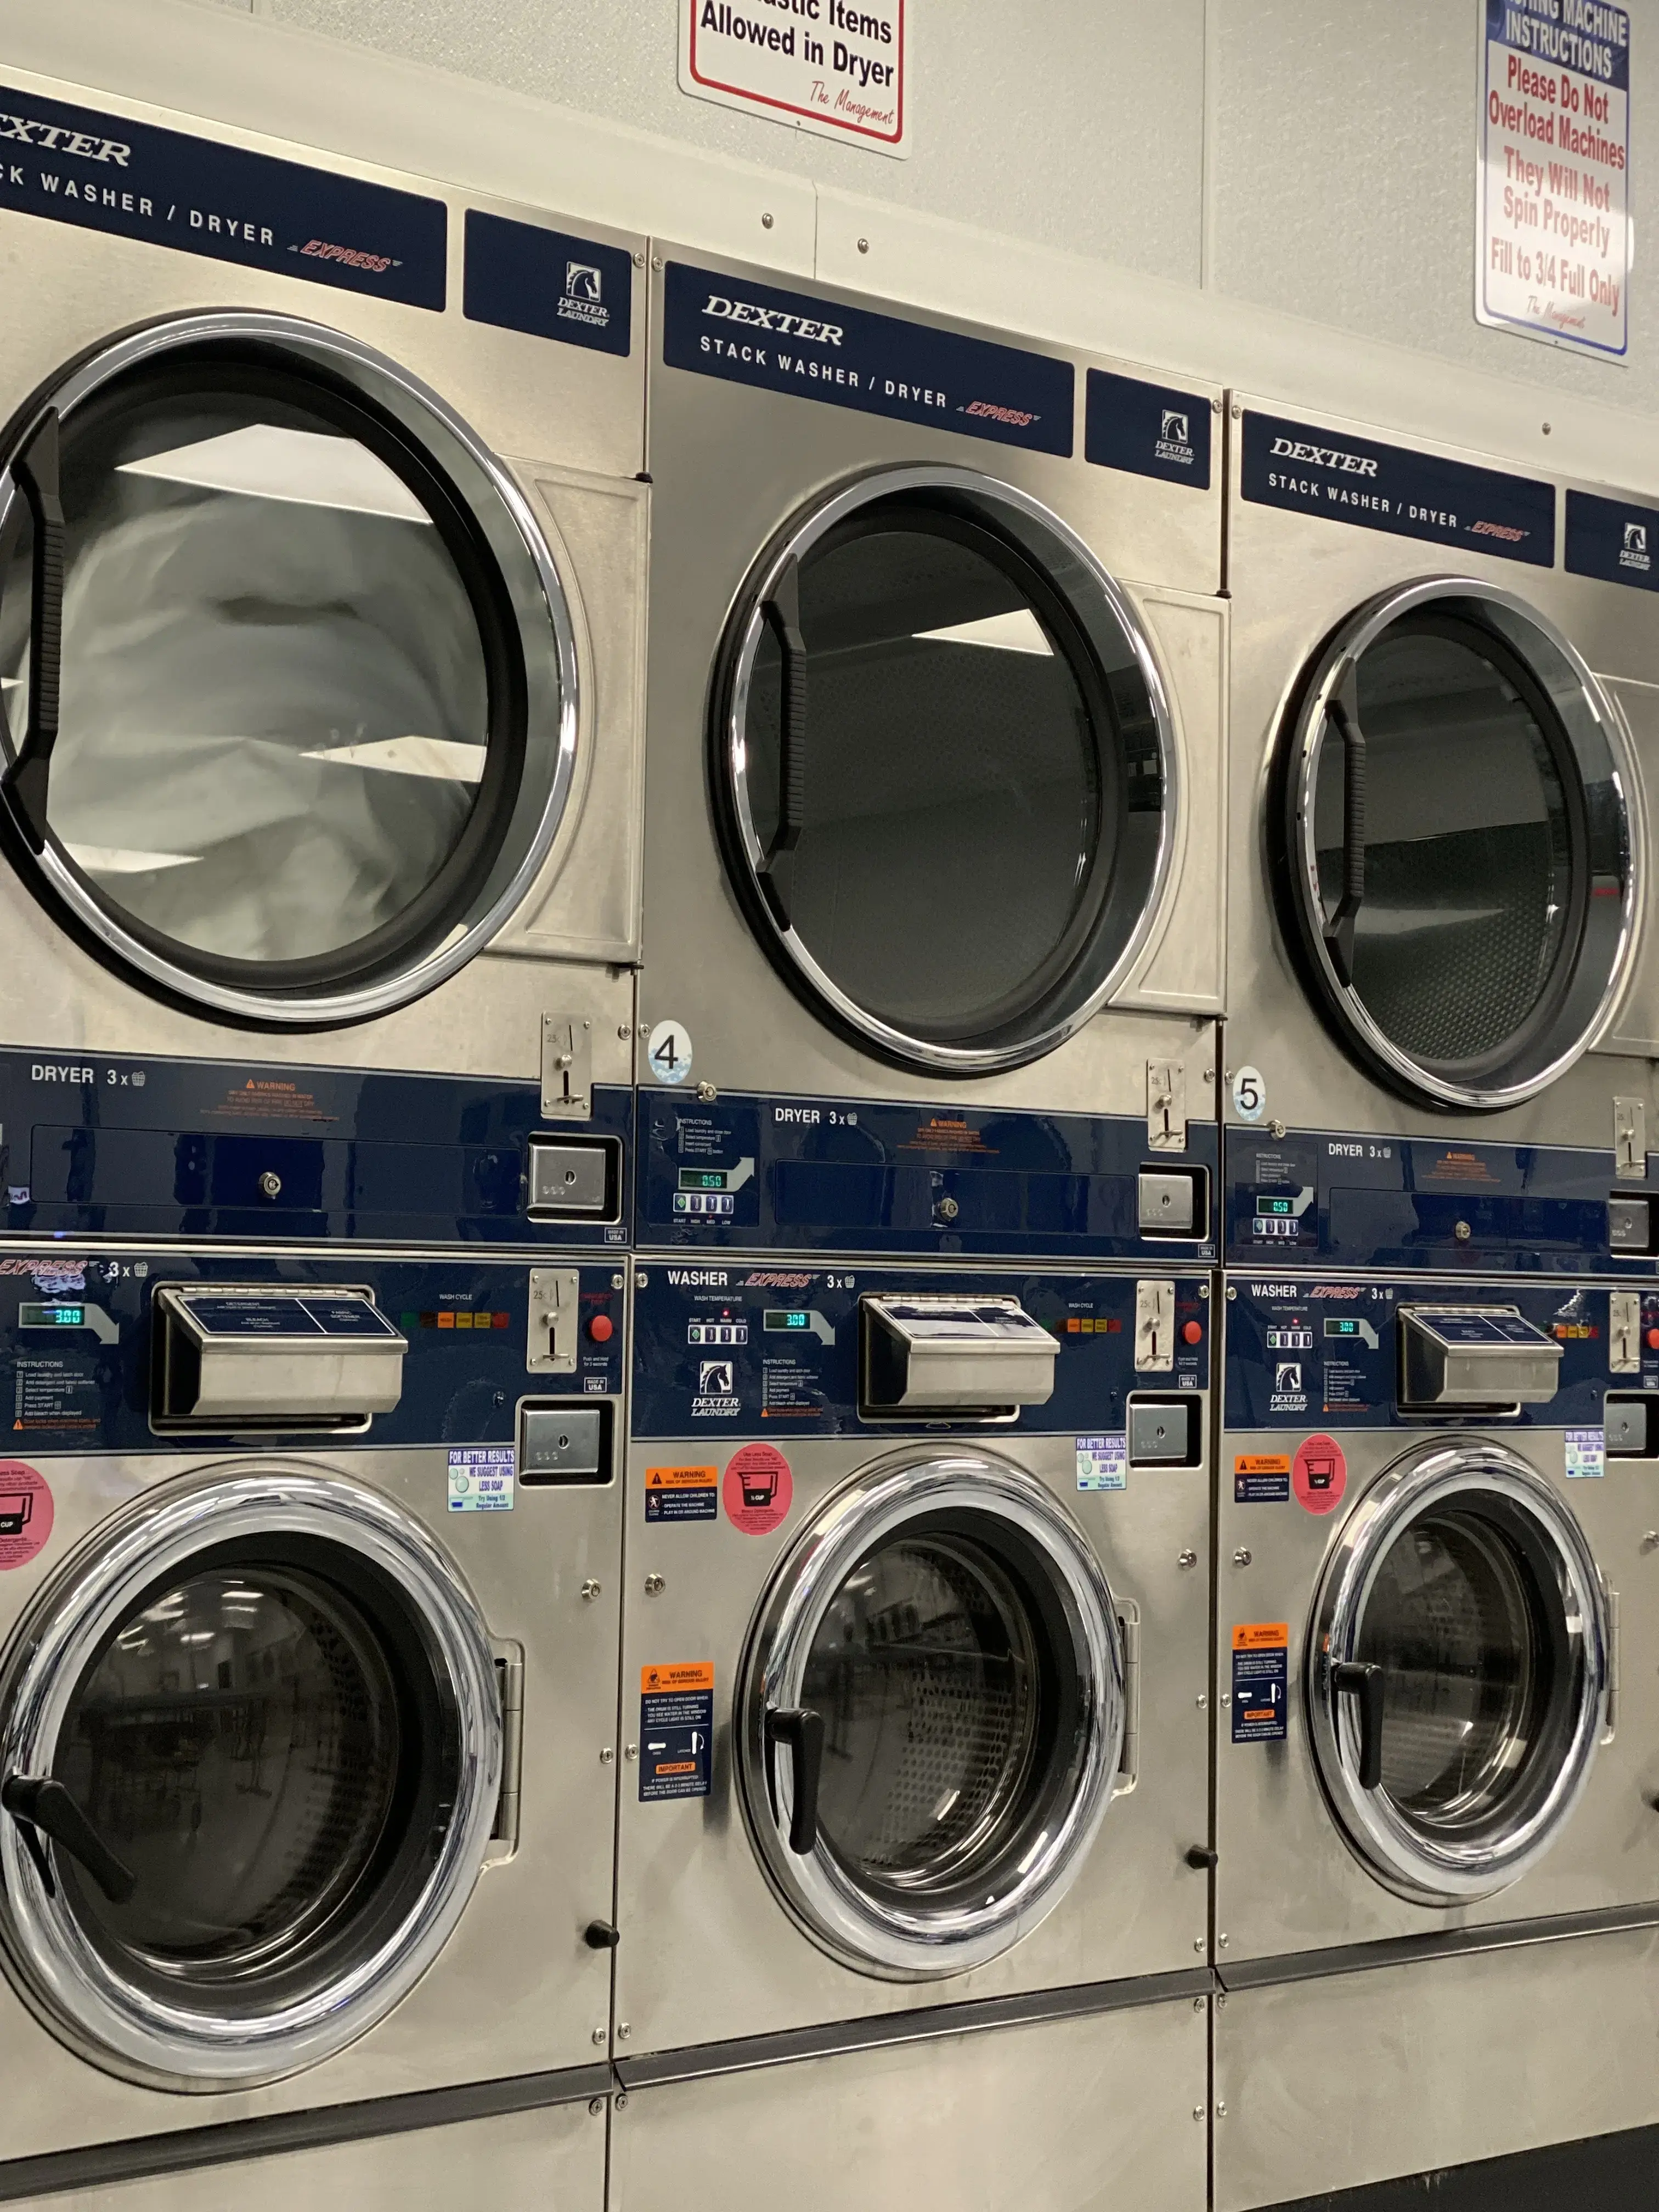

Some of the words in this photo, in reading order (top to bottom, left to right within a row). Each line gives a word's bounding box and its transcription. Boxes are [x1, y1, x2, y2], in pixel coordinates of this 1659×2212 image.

[829, 0, 892, 43] Items
[1564, 0, 1627, 47] MACHINE
[701, 0, 794, 57] Allowed
[804, 31, 823, 65] in
[833, 41, 894, 87] Dryer
[1505, 9, 1612, 78] INSTRUCTIONS
[1508, 54, 1556, 104] Please
[1561, 74, 1579, 112] Do
[1584, 83, 1609, 124] Not
[810, 81, 829, 104] The
[834, 89, 894, 125] Management
[1489, 90, 1554, 145] Overload
[1559, 114, 1625, 170] Machines
[1504, 145, 1544, 197] They
[1548, 161, 1578, 201] Will
[1583, 173, 1610, 212] Not
[41, 172, 153, 216] WASHER
[167, 205, 176, 221] /
[190, 210, 273, 246] DRYER
[300, 240, 391, 272] EXPRESS
[1504, 185, 1538, 229] Spin
[1544, 198, 1610, 258] Properly
[1491, 236, 1513, 275] Fill
[1517, 246, 1532, 281] to
[1536, 251, 1556, 289] 3/4
[1560, 259, 1585, 298] Full
[1589, 269, 1620, 317] Only
[557, 297, 609, 318] DEXTER
[557, 307, 610, 326] LAUNDRY
[701, 295, 843, 346] DEXTER
[701, 336, 766, 365] STACK
[778, 354, 859, 387] WASHER
[868, 376, 875, 391] /
[885, 380, 946, 408] DRYER
[966, 400, 1032, 426] EXPRESS
[1155, 440, 1194, 456] DEXTER
[1155, 450, 1194, 465] LAUNDRY
[1269, 438, 1379, 477] DEXTER
[1268, 473, 1319, 496] STACK
[1328, 487, 1390, 512] WASHER
[1397, 503, 1402, 515] /
[1409, 505, 1457, 528] DRYER
[1471, 521, 1524, 542] EXPRESS
[654, 1035, 678, 1069] 4
[31, 1065, 94, 1084] DRYER
[107, 1070, 116, 1085] 3
[257, 1081, 295, 1091] WARNING
[1240, 1078, 1258, 1110] 5
[776, 1108, 820, 1123] DRYER
[830, 1112, 837, 1124] 3
[1329, 1143, 1363, 1156] DRYER
[1370, 1146, 1376, 1158] 3
[0, 1260, 88, 1275] EXPRESS
[110, 1262, 119, 1277] 3
[668, 1271, 727, 1285] WASHER
[745, 1273, 812, 1288] EXPRESS
[827, 1276, 834, 1288] 3
[1251, 1284, 1297, 1297] WASHER
[1310, 1286, 1359, 1299] EXPRESS
[1372, 1288, 1378, 1300] 3
[691, 1397, 740, 1407] DEXTER
[1270, 1395, 1307, 1403] DEXTER
[691, 1408, 741, 1417] LAUNDRY
[1077, 1438, 1086, 1449] FOR
[1087, 1438, 1105, 1449] BETTER
[1105, 1437, 1126, 1448] RESULTS
[449, 1451, 462, 1464] FOR
[463, 1451, 486, 1464] BETTER
[488, 1450, 514, 1463] RESULTS
[469, 1466, 476, 1477] WE
[477, 1466, 498, 1477] SUGGEST
[499, 1466, 513, 1476] USING
[1099, 1464, 1108, 1473] LESS
[1109, 1464, 1118, 1472] SOAP
[479, 1481, 489, 1491] LESS
[492, 1480, 503, 1491] SOAP
[669, 1670, 703, 1679] WARNING
[659, 1764, 692, 1772] IMPORTANT
